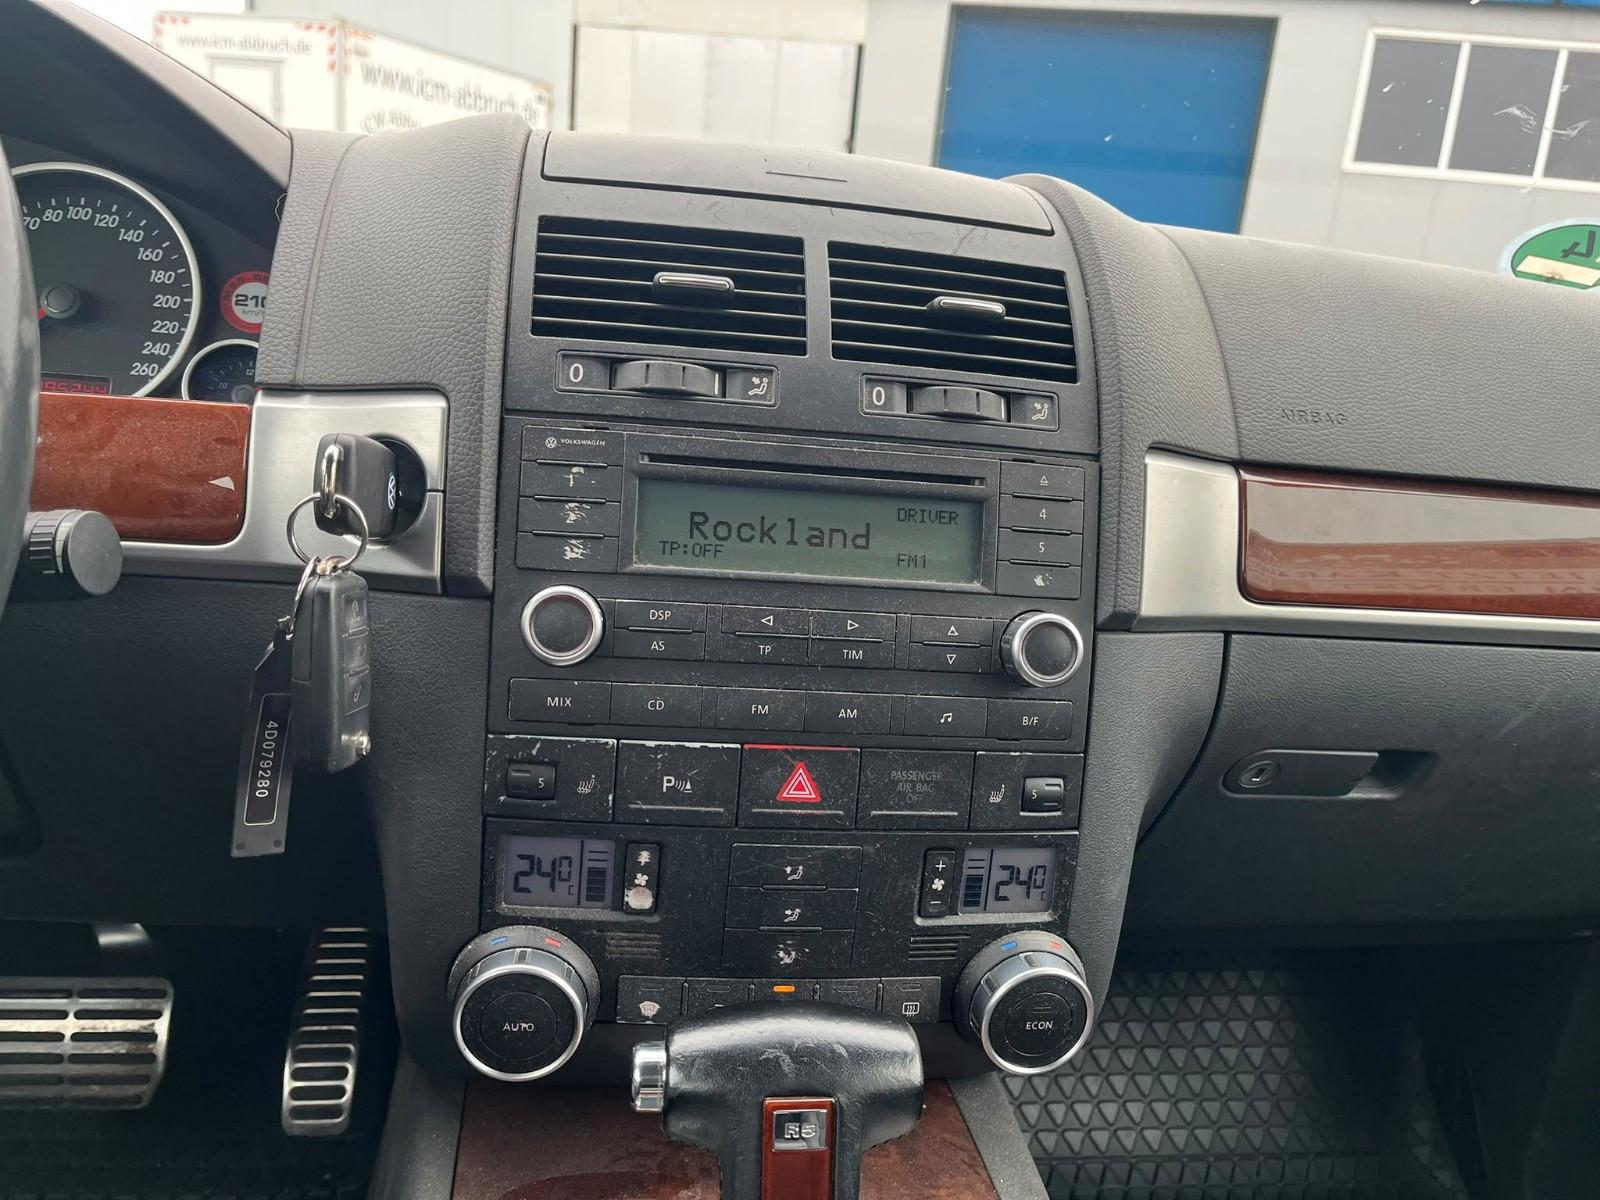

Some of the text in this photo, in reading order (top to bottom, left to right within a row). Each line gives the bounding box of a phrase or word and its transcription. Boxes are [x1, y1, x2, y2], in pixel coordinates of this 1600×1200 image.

[42, 209, 63, 222] 80
[66, 206, 92, 220] 100
[94, 214, 119, 228] 120
[118, 228, 144, 242] 140
[137, 247, 163, 262] 160
[150, 269, 175, 284] 180
[153, 294, 181, 309] 200
[151, 320, 179, 334] 220
[142, 341, 170, 356] 240
[130, 363, 158, 377] 260
[569, 363, 584, 383] 0
[872, 386, 886, 406] 0
[1281, 408, 1349, 424] AIRBAG
[560, 437, 606, 447] VOLKSWAGEN
[897, 508, 960, 525] DRIVER
[1039, 508, 1047, 519] 4
[689, 511, 871, 550] Rockland
[1038, 542, 1046, 553] 5
[897, 553, 927, 569] FM1
[649, 609, 672, 621] DSP
[651, 640, 665, 651] AS
[758, 645, 772, 656] TP
[842, 649, 863, 660] TIM
[546, 696, 572, 708] MIX
[647, 700, 665, 711] CD
[751, 704, 769, 715] FM
[838, 708, 858, 719] AM
[1022, 716, 1040, 726] B/F
[255, 720, 280, 798] 4D079280
[890, 770, 943, 782] PASSENGER
[896, 782, 935, 793] AIR BAG
[905, 793, 923, 805] OFF
[502, 1022, 535, 1032] AUTO
[1025, 1021, 1054, 1031] ECON
